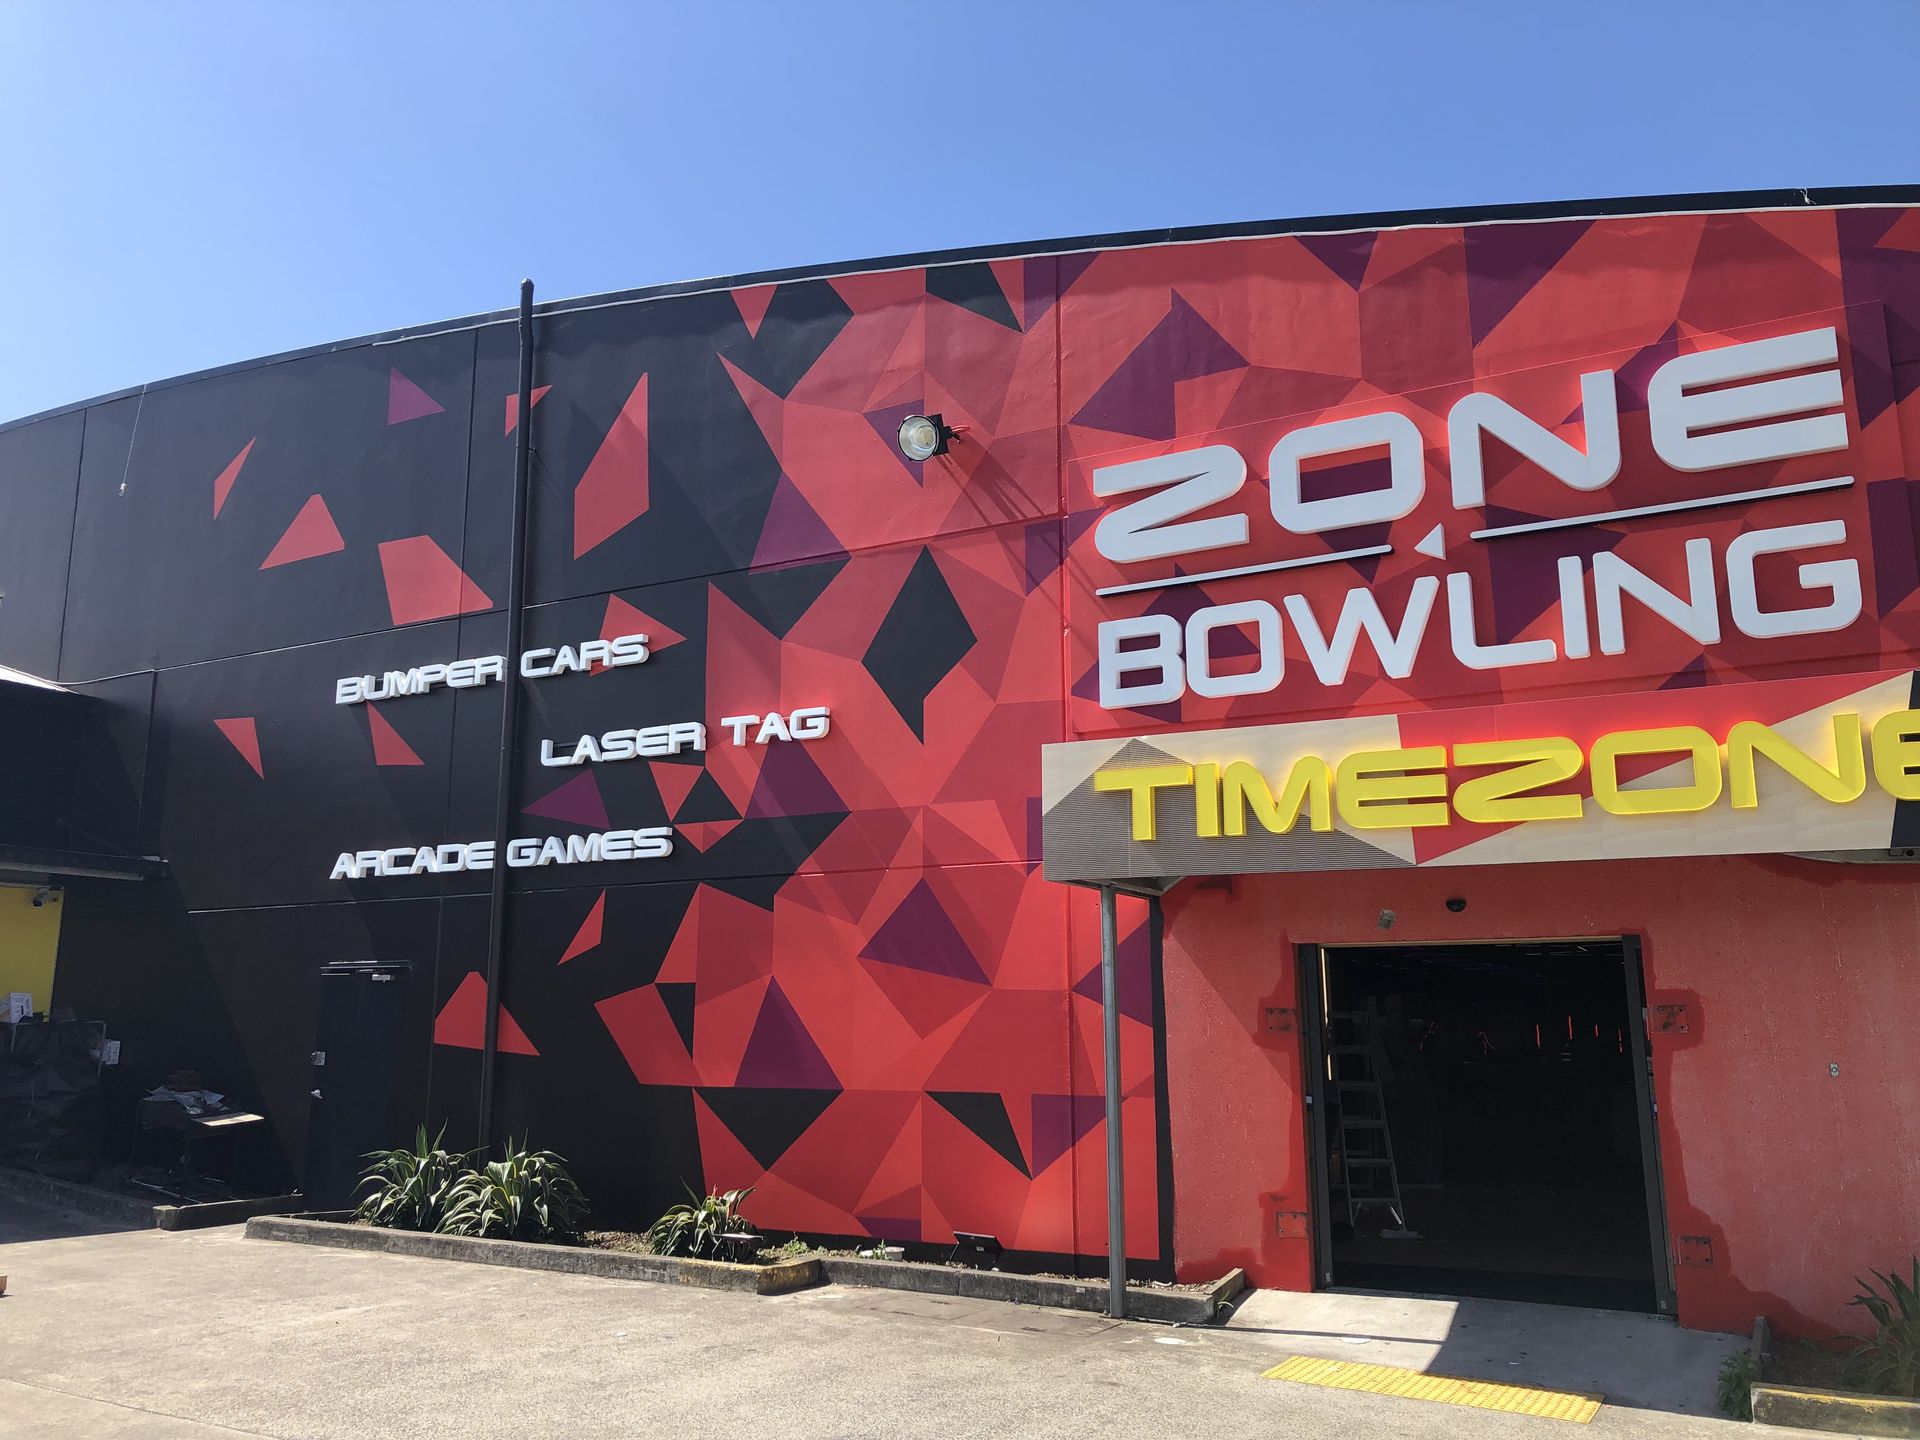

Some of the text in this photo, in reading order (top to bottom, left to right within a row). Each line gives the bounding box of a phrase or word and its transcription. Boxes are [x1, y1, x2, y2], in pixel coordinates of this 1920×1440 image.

[1093, 327, 1848, 563] ZONE
[1098, 520, 1863, 709] BOWLING
[335, 633, 649, 704] BUMPER CARS
[540, 706, 831, 768] LASER TAG
[329, 827, 674, 880] ARCADE GAMES
